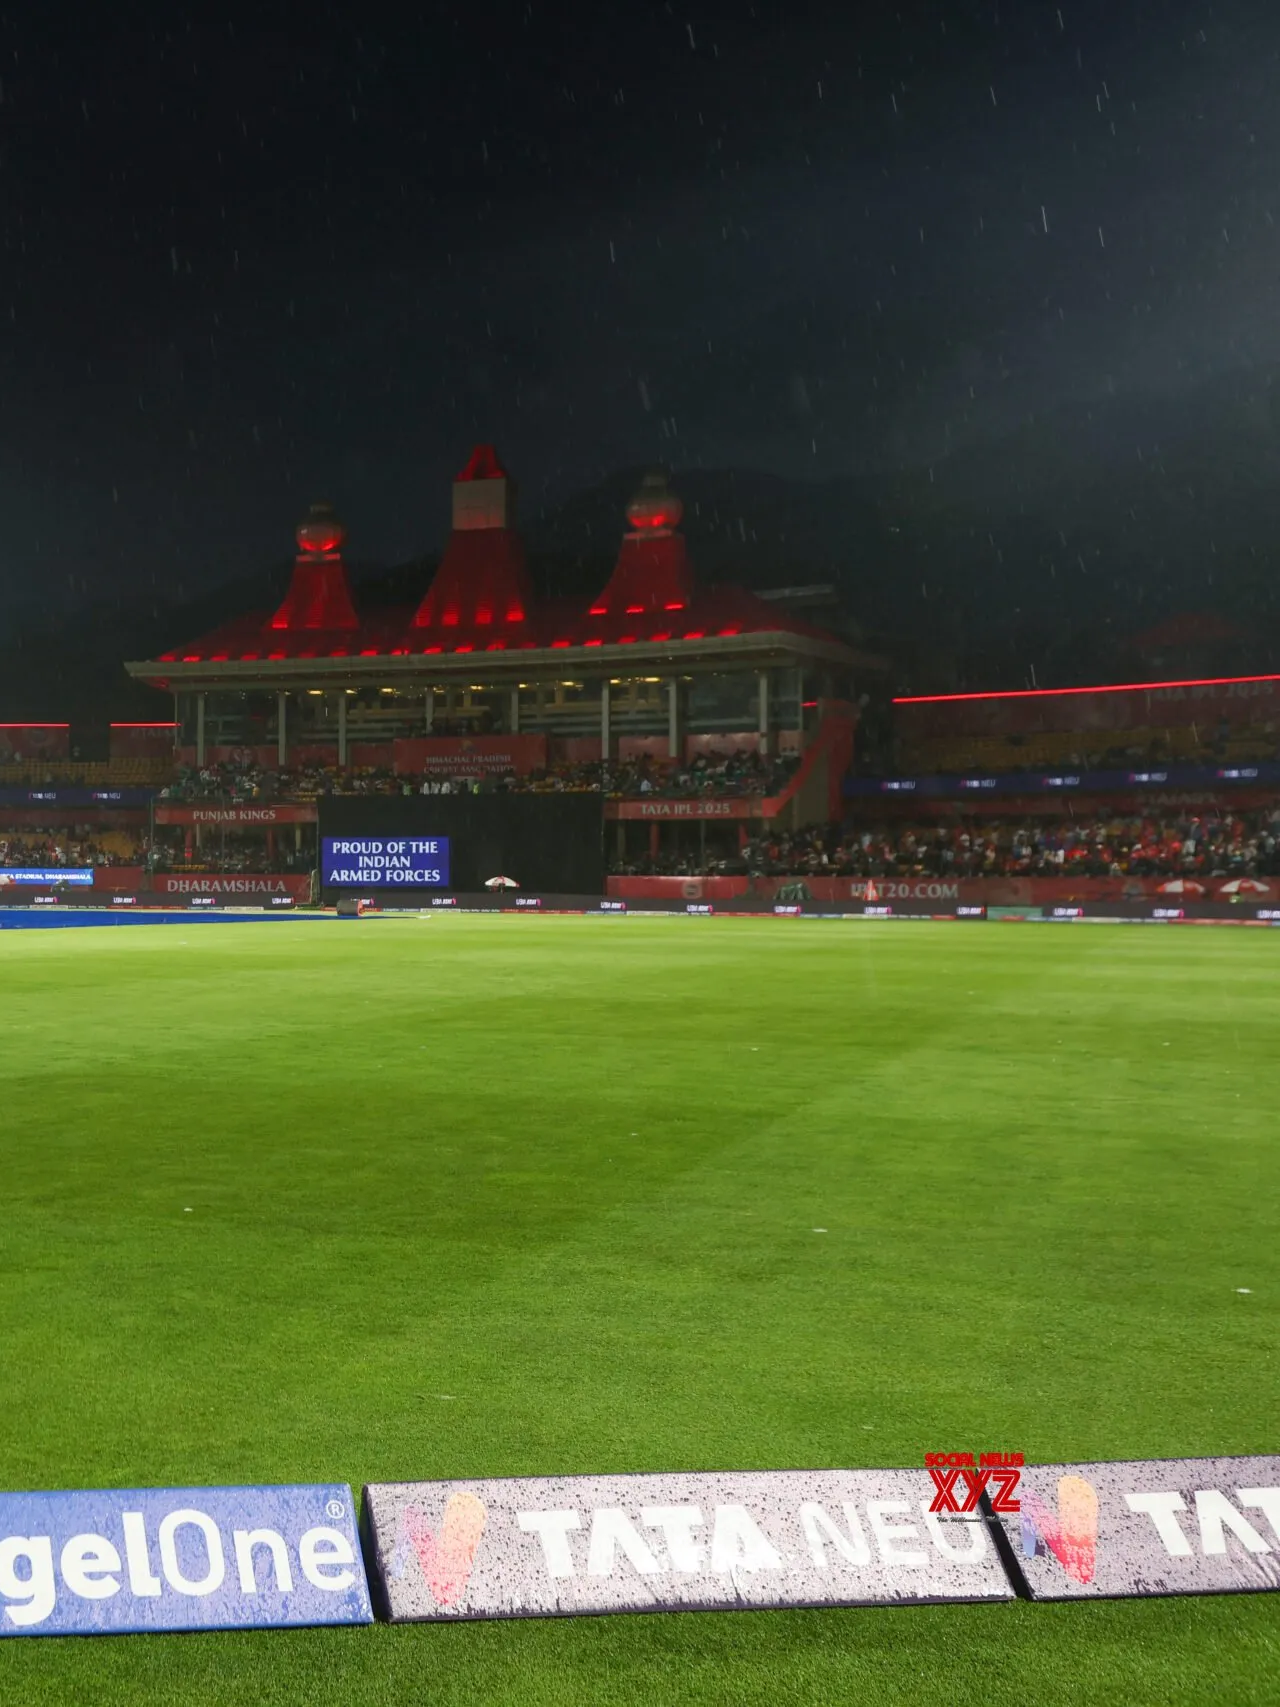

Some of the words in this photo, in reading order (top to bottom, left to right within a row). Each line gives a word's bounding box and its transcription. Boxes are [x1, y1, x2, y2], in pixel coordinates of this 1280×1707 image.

[642, 804, 671, 815] TATA
[674, 804, 692, 814] IPL
[193, 810, 236, 823] PUNJAB
[239, 810, 276, 820] KINGS
[332, 842, 383, 854] PROUD
[386, 842, 407, 853] OF
[410, 841, 438, 853] THE
[358, 855, 411, 868] INDIAN
[330, 869, 382, 882] ARMED
[386, 869, 441, 882] FORCES
[167, 880, 287, 893] DHARAMSHALA
[517, 1503, 782, 1578] TATA
[800, 1500, 988, 1567] NEU
